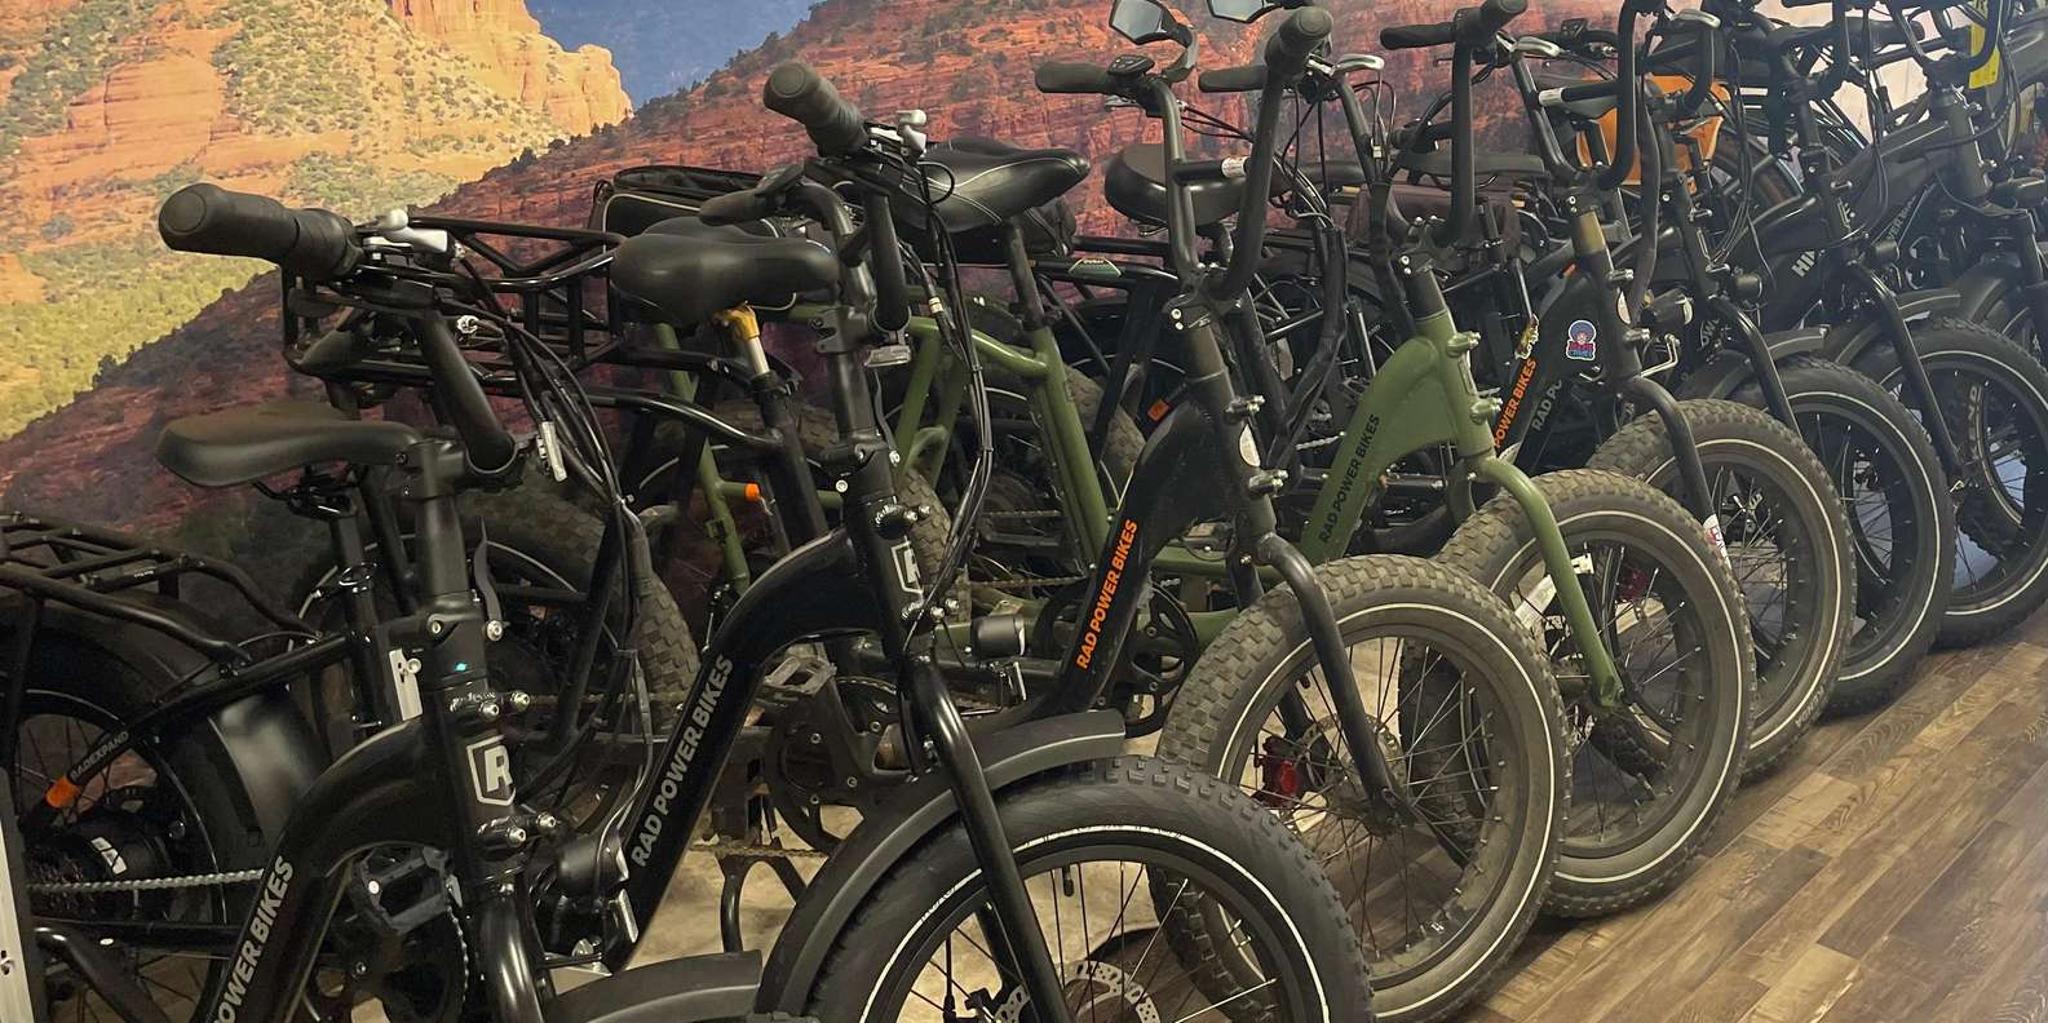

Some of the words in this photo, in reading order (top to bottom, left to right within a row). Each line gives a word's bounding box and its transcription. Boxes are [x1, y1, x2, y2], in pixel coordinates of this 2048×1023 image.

[1513, 359, 1536, 399] BIKES
[1531, 400, 1553, 432] RAD
[1319, 512, 1338, 543] RAD
[1333, 458, 1362, 512] POWER
[1355, 414, 1380, 458] BIKES
[1076, 631, 1097, 669] RAD
[1090, 570, 1120, 632] POWER
[1111, 519, 1137, 571] BIKES
[484, 745, 513, 792] R
[631, 814, 662, 867] RAD
[653, 726, 704, 816] POWER
[692, 654, 734, 729] BIKES
[214, 940, 262, 1023] OWER
[250, 855, 293, 944] BIKES
